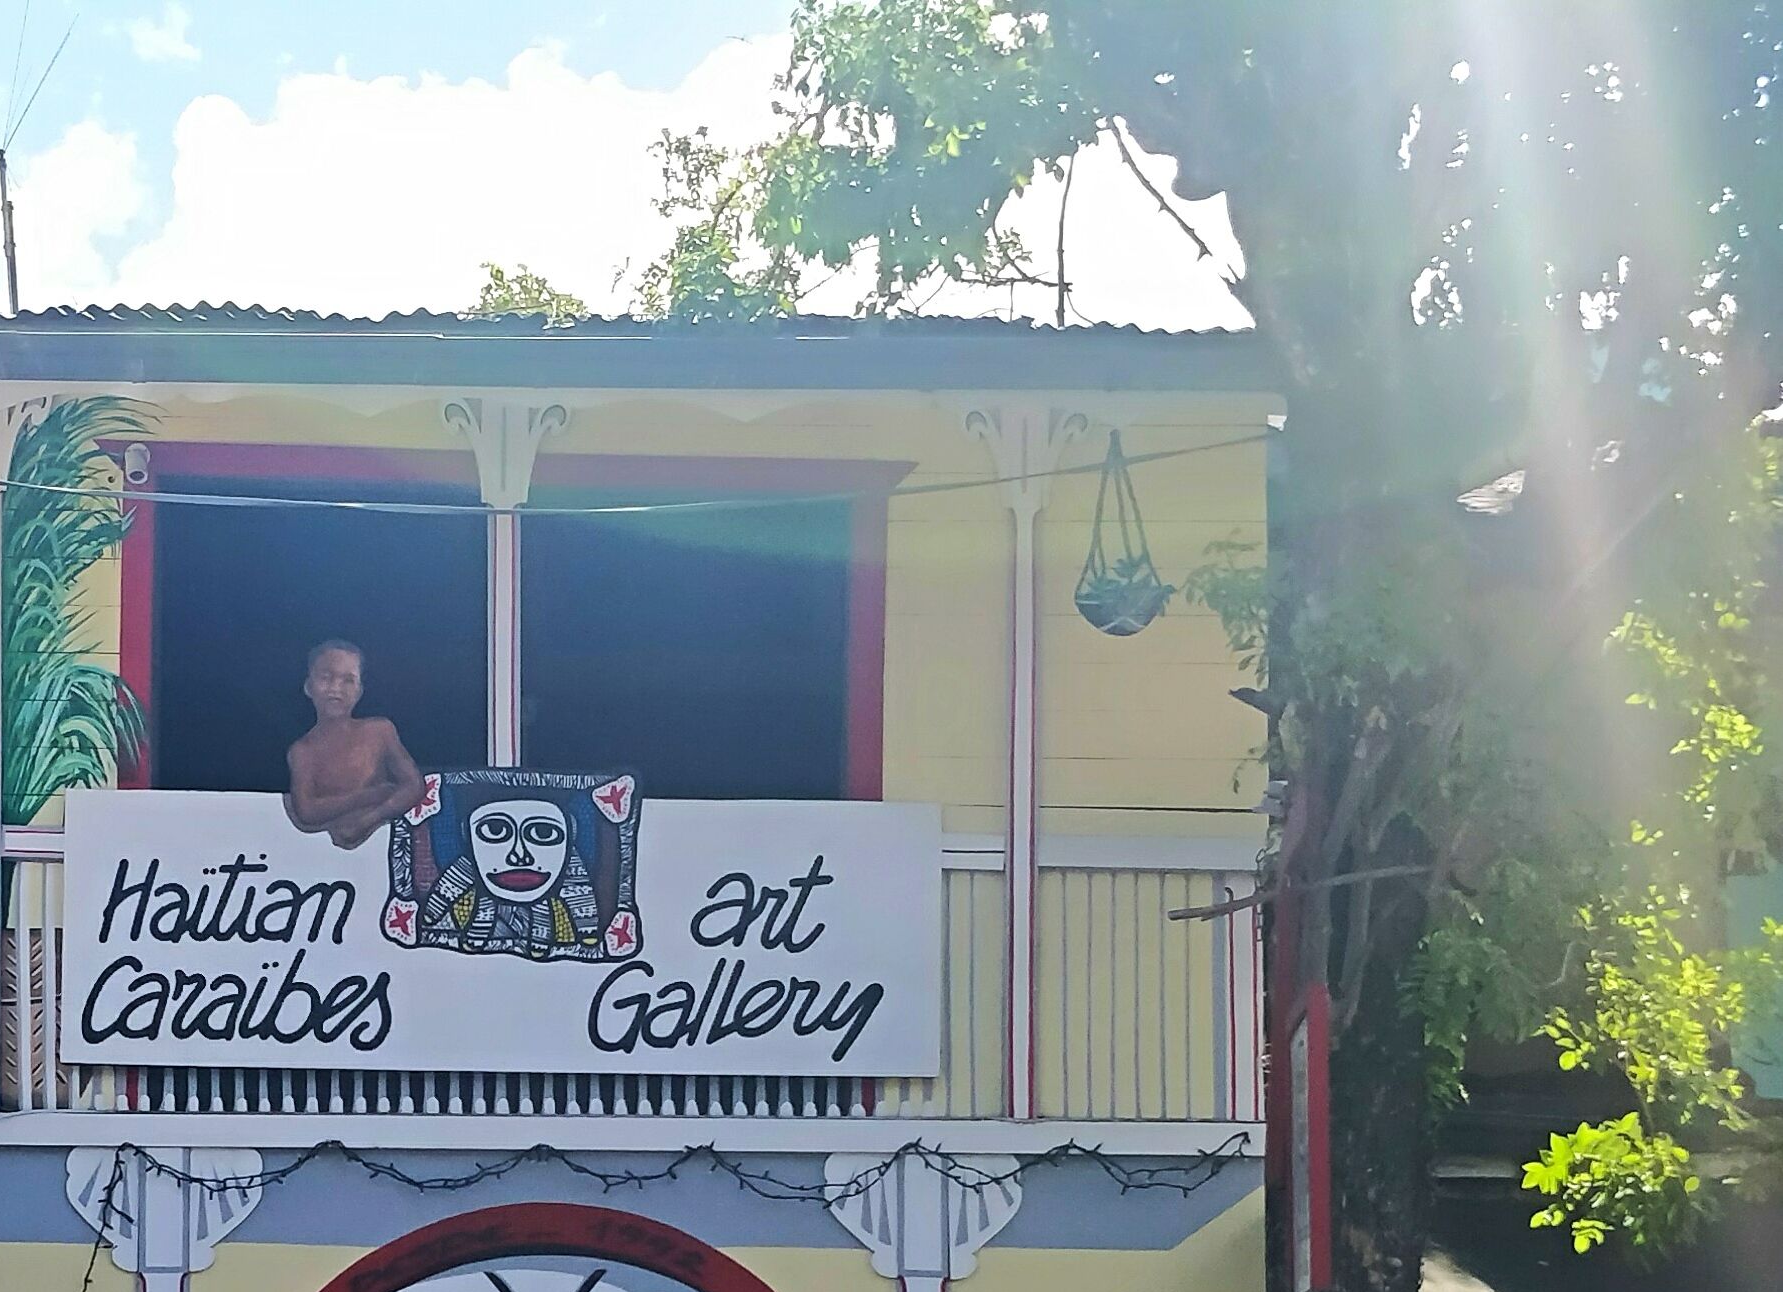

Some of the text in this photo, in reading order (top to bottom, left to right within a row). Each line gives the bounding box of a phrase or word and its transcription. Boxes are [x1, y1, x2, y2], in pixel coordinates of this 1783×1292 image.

[98, 854, 834, 953] Haïtian art
[81, 949, 884, 1062] Caraïbes Gallery
